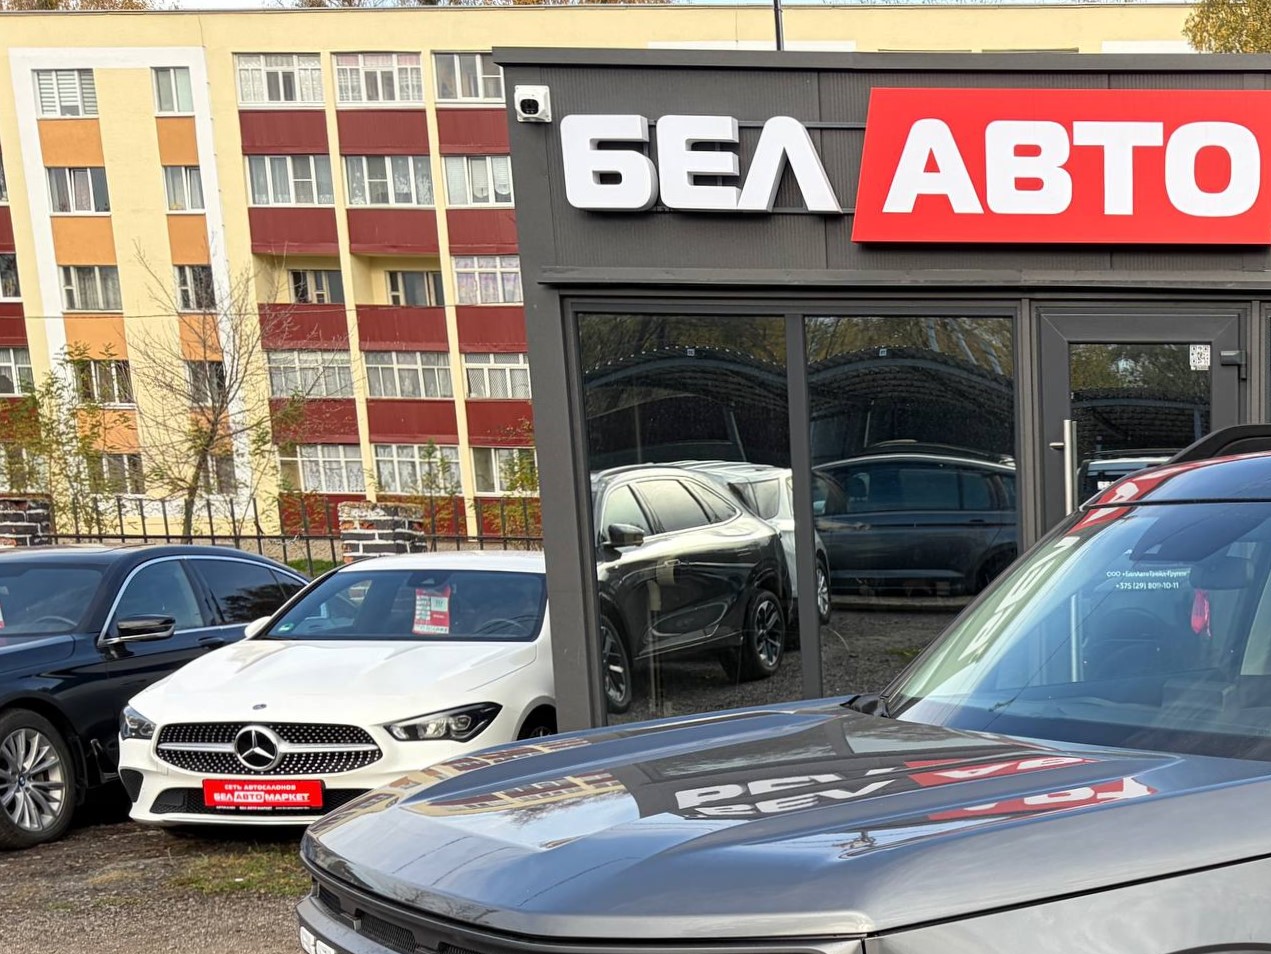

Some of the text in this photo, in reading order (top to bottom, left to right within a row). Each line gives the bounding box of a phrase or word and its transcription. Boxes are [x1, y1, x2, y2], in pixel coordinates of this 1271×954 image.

[560, 114, 843, 213] БЕЛ
[882, 118, 1261, 218] АВТО
[213, 792, 310, 802] БЕЛ АВТО МАРКЕТ
